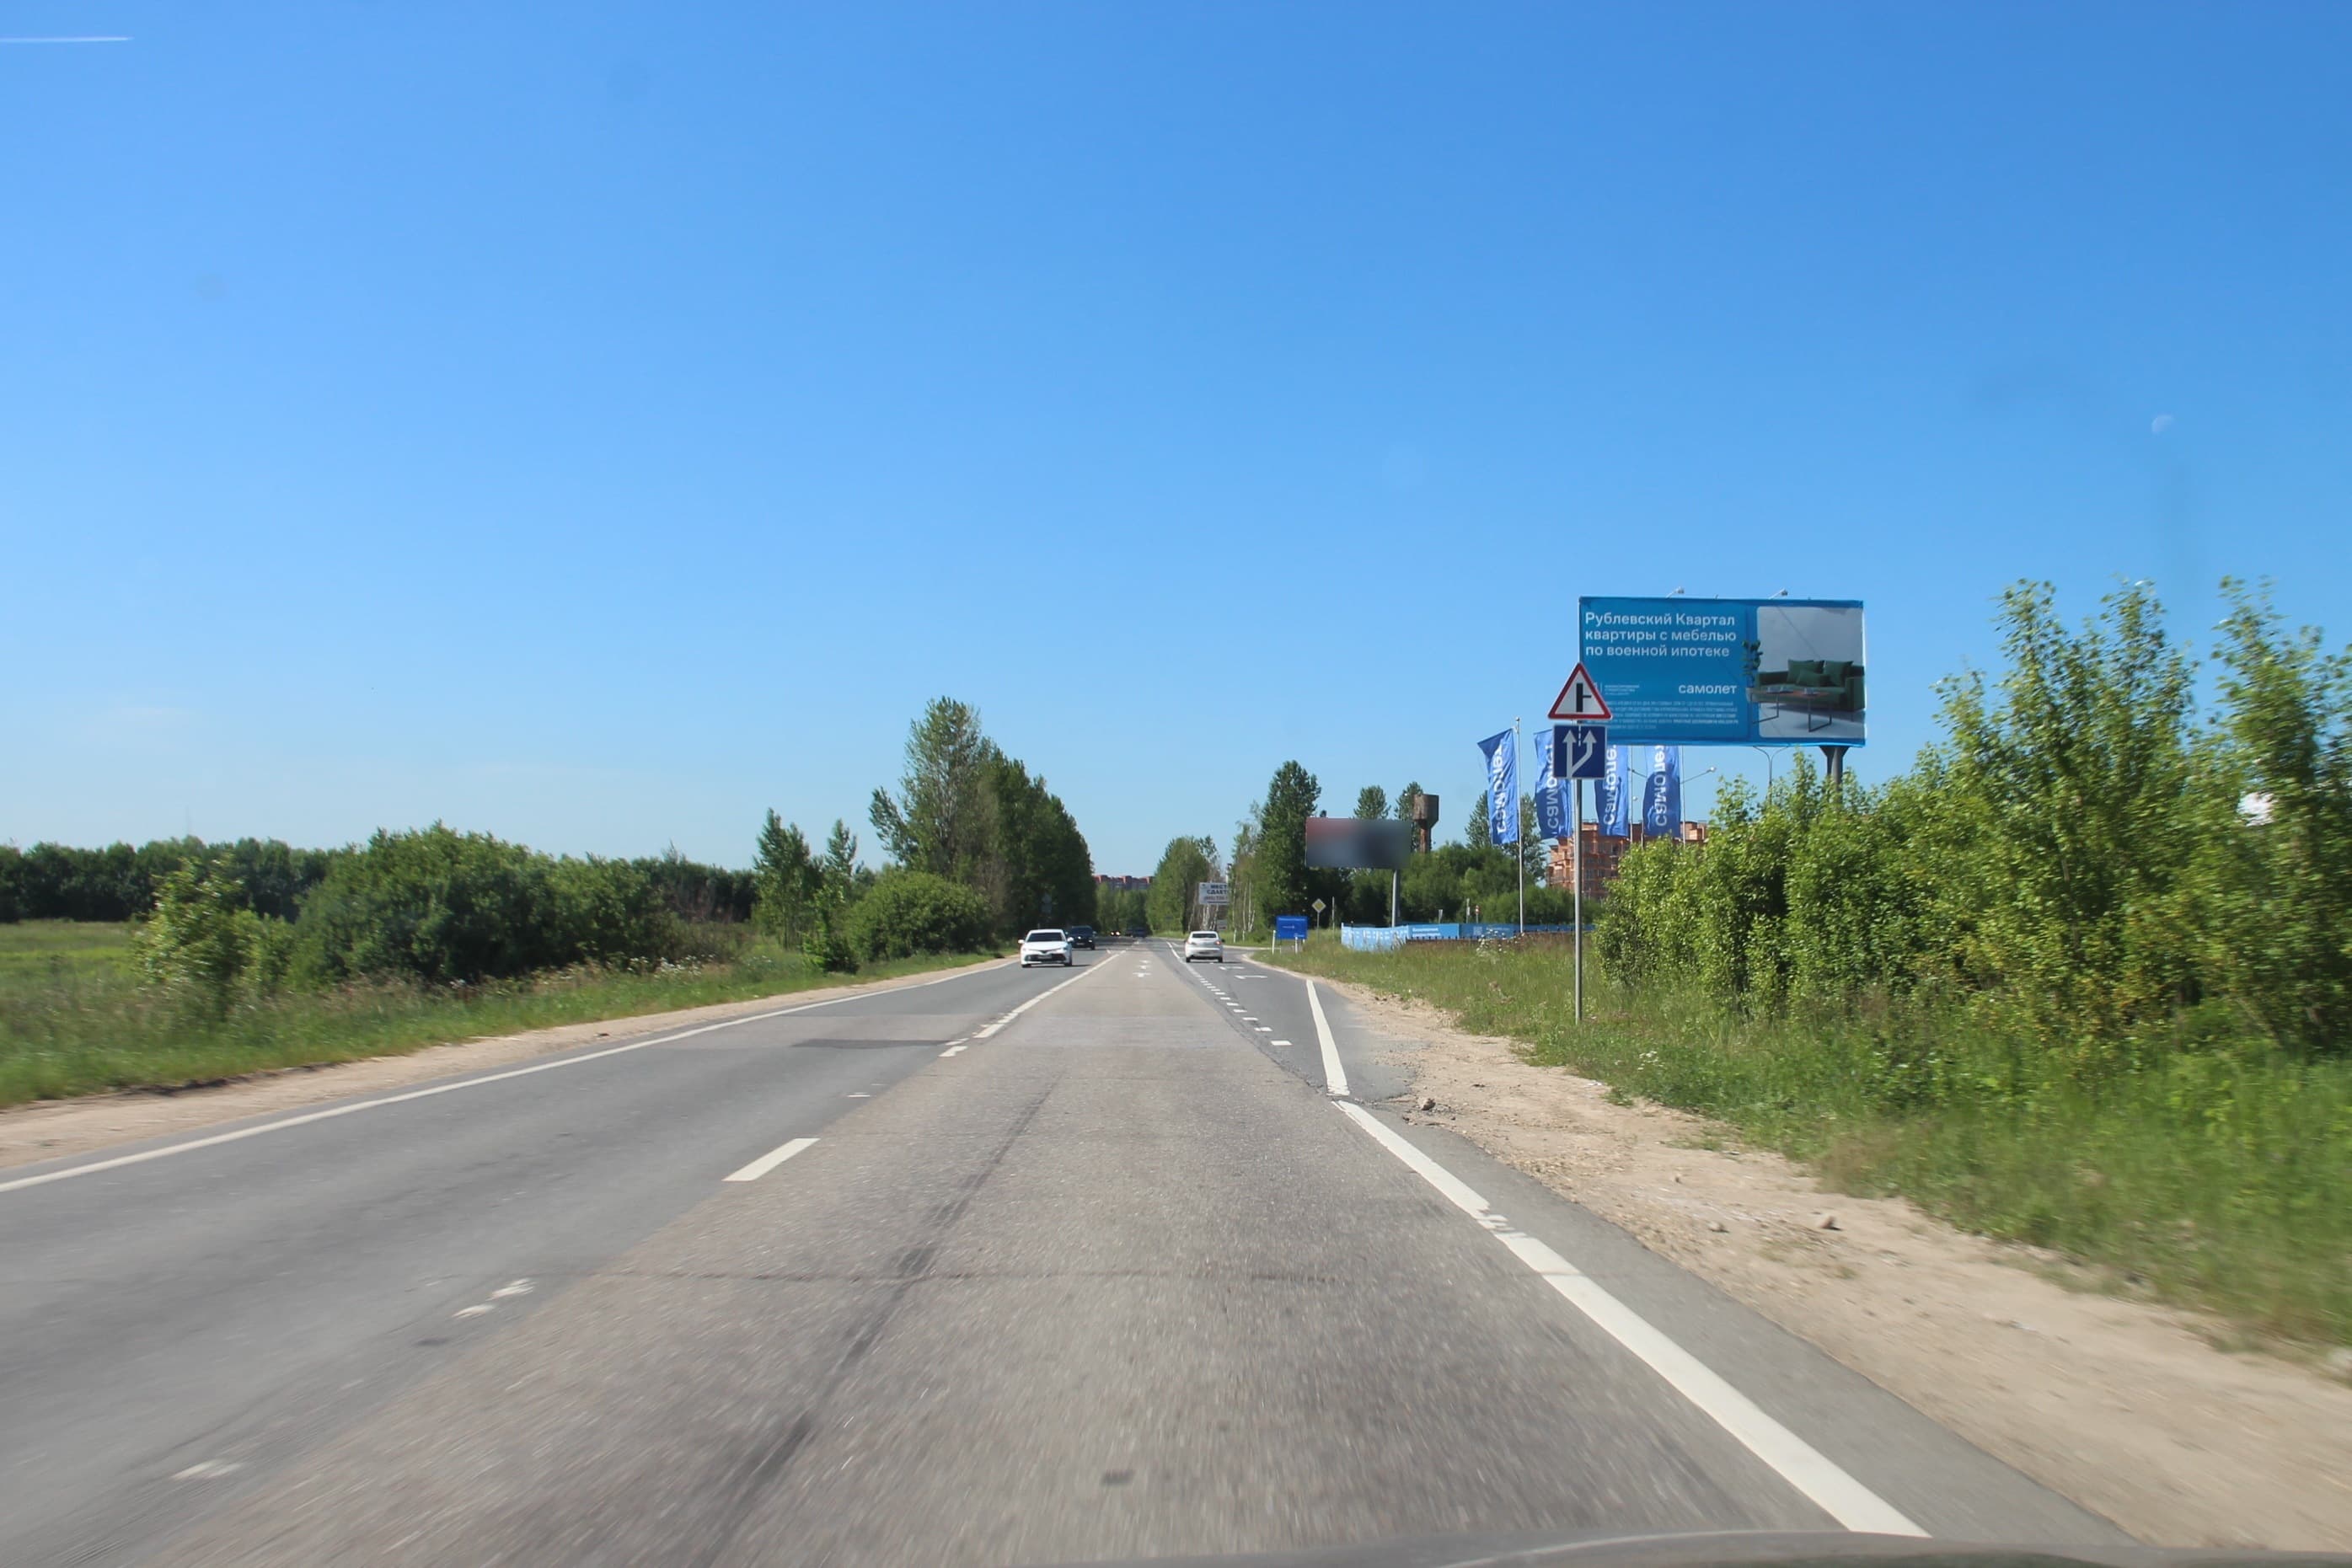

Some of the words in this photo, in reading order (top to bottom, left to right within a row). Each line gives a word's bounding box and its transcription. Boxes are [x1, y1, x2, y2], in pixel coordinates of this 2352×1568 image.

[1585, 612, 1672, 627] Рублевский
[1676, 613, 1735, 628] Квартал
[1585, 631, 1656, 643] квартиры
[1659, 632, 1668, 640] с
[1671, 629, 1737, 641] мебелью
[1585, 646, 1603, 656] по
[1607, 645, 1668, 657] военной
[1671, 647, 1730, 657] ипотеке
[1678, 683, 1738, 694] самолет
